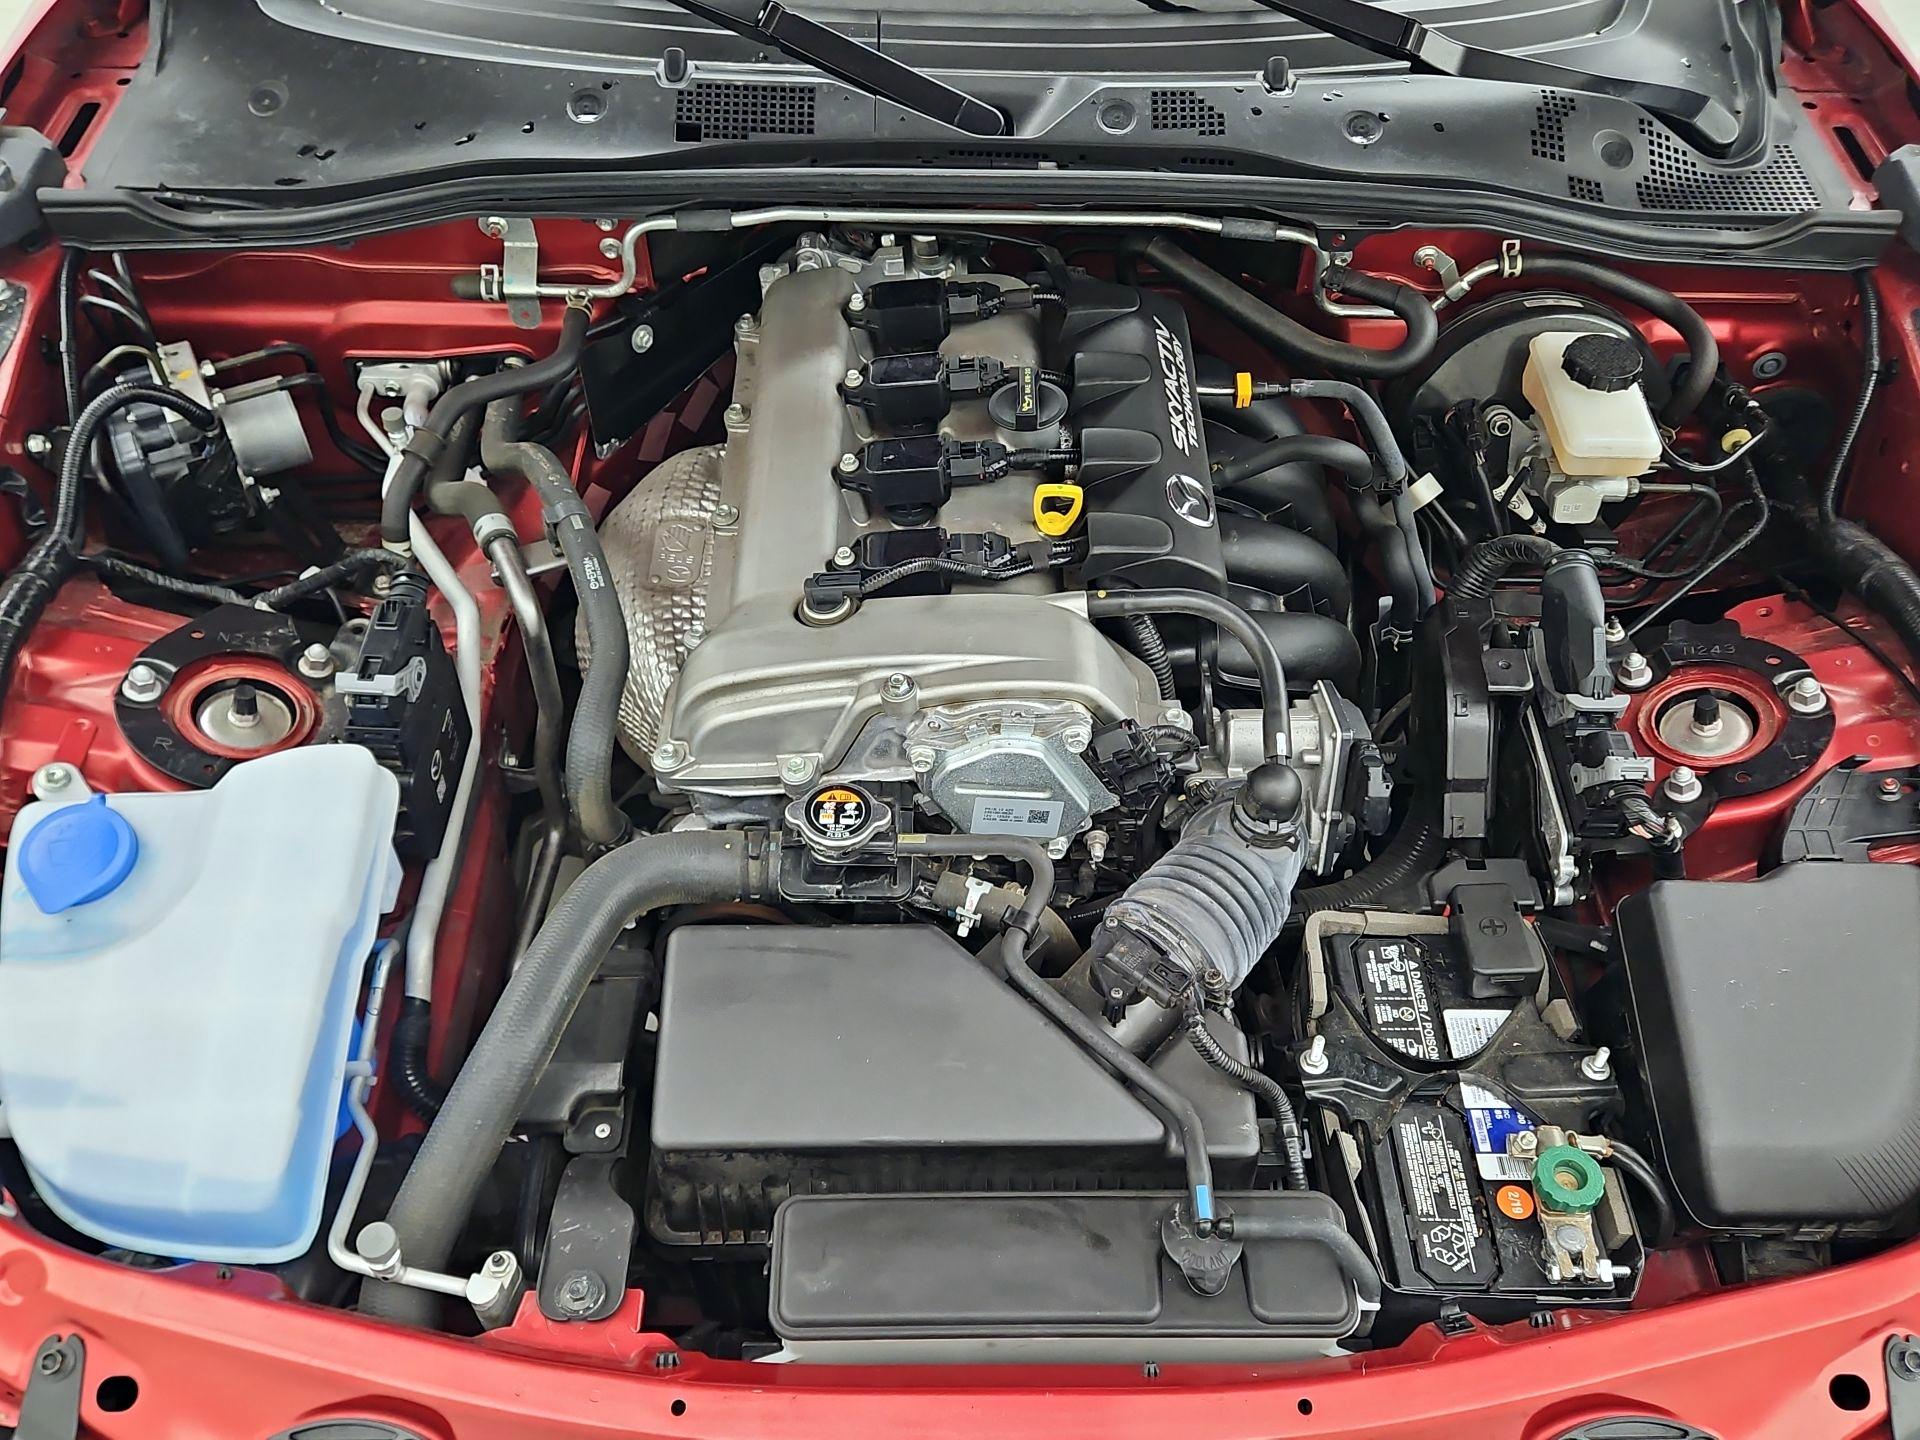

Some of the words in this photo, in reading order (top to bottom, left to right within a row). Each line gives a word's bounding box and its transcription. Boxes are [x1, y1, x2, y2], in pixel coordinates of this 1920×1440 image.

[1153, 315, 1190, 457] SKYACTIV
[1171, 332, 1199, 448] TECHNOLOGY
[153, 736, 173, 751] R
[1410, 971, 1428, 1011] DANGER
[1422, 1022, 1439, 1060] POISON
[1503, 1110, 1510, 1118] RC
[1436, 1140, 1445, 1157] FLUSH
[1440, 1158, 1448, 1171] EYES
[1431, 1179, 1439, 1193] FAST
[1443, 1173, 1457, 1209] IMMEDIATELY
